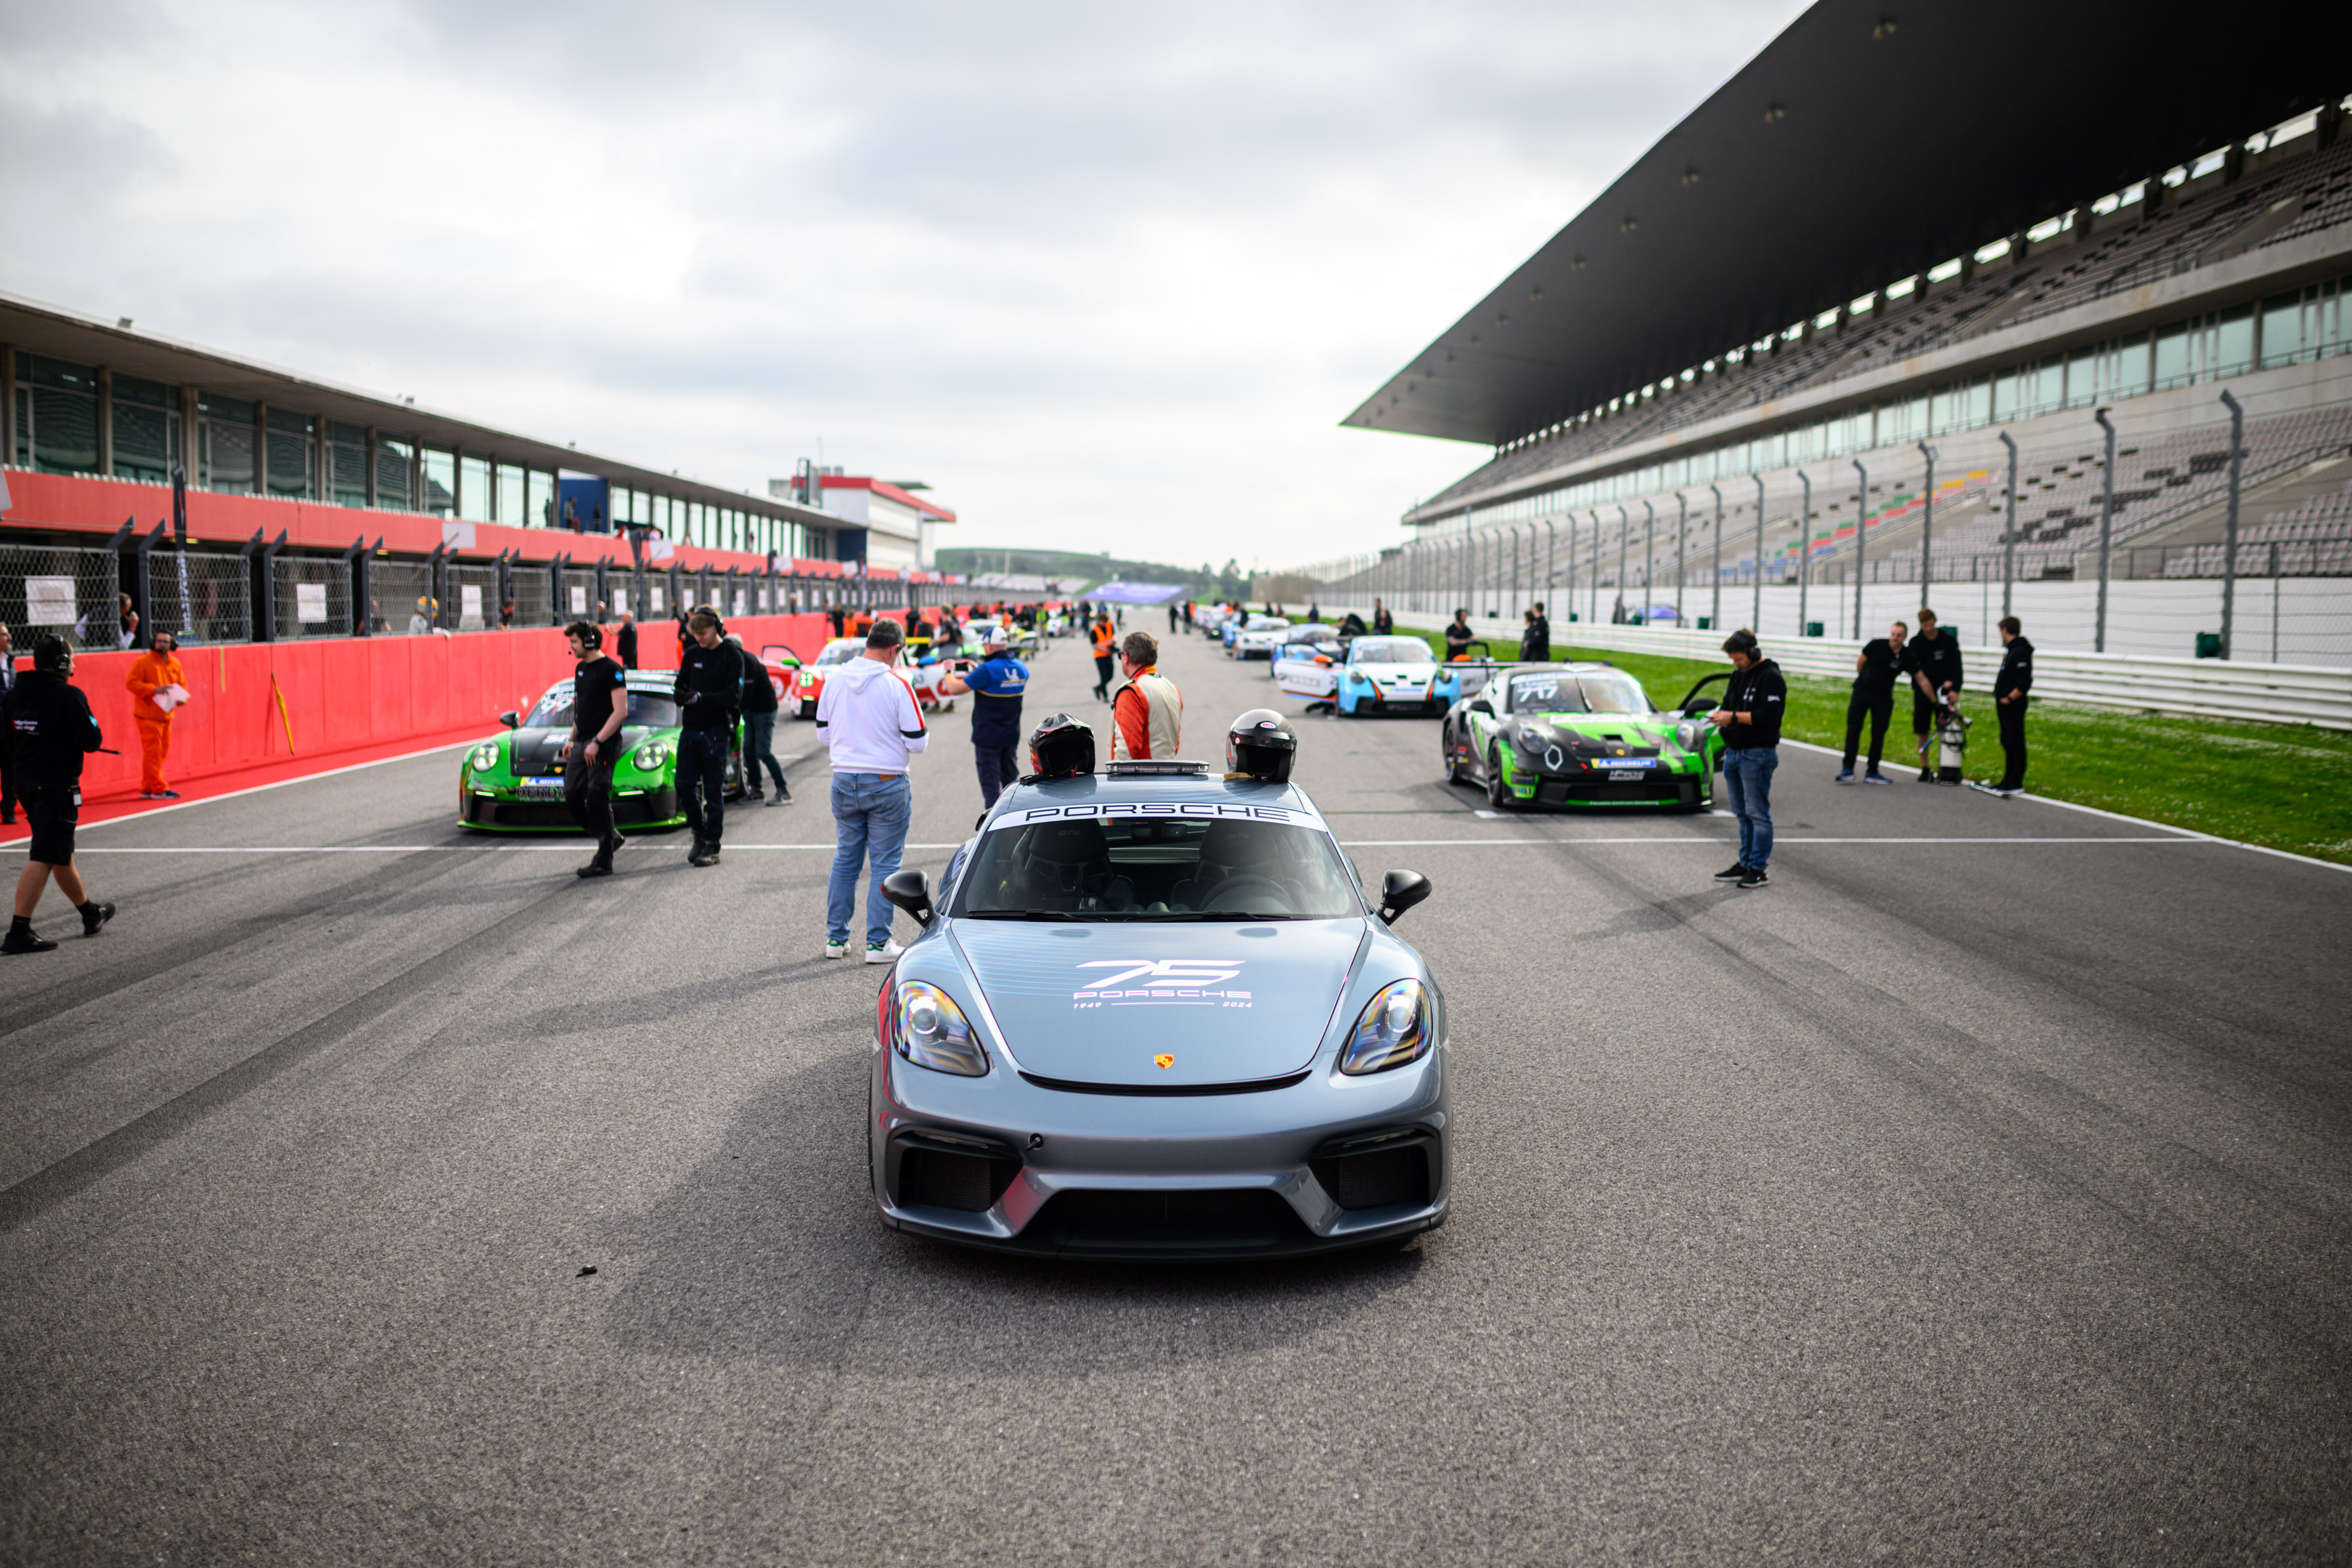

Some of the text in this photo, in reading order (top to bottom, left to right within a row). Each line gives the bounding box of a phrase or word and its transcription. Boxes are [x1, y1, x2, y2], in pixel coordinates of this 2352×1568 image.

[1517, 685, 1558, 703] 717
[1025, 804, 1290, 822] PORSCHE
[1075, 959, 1246, 989] 75
[1074, 989, 1251, 1000] PORSCHE
